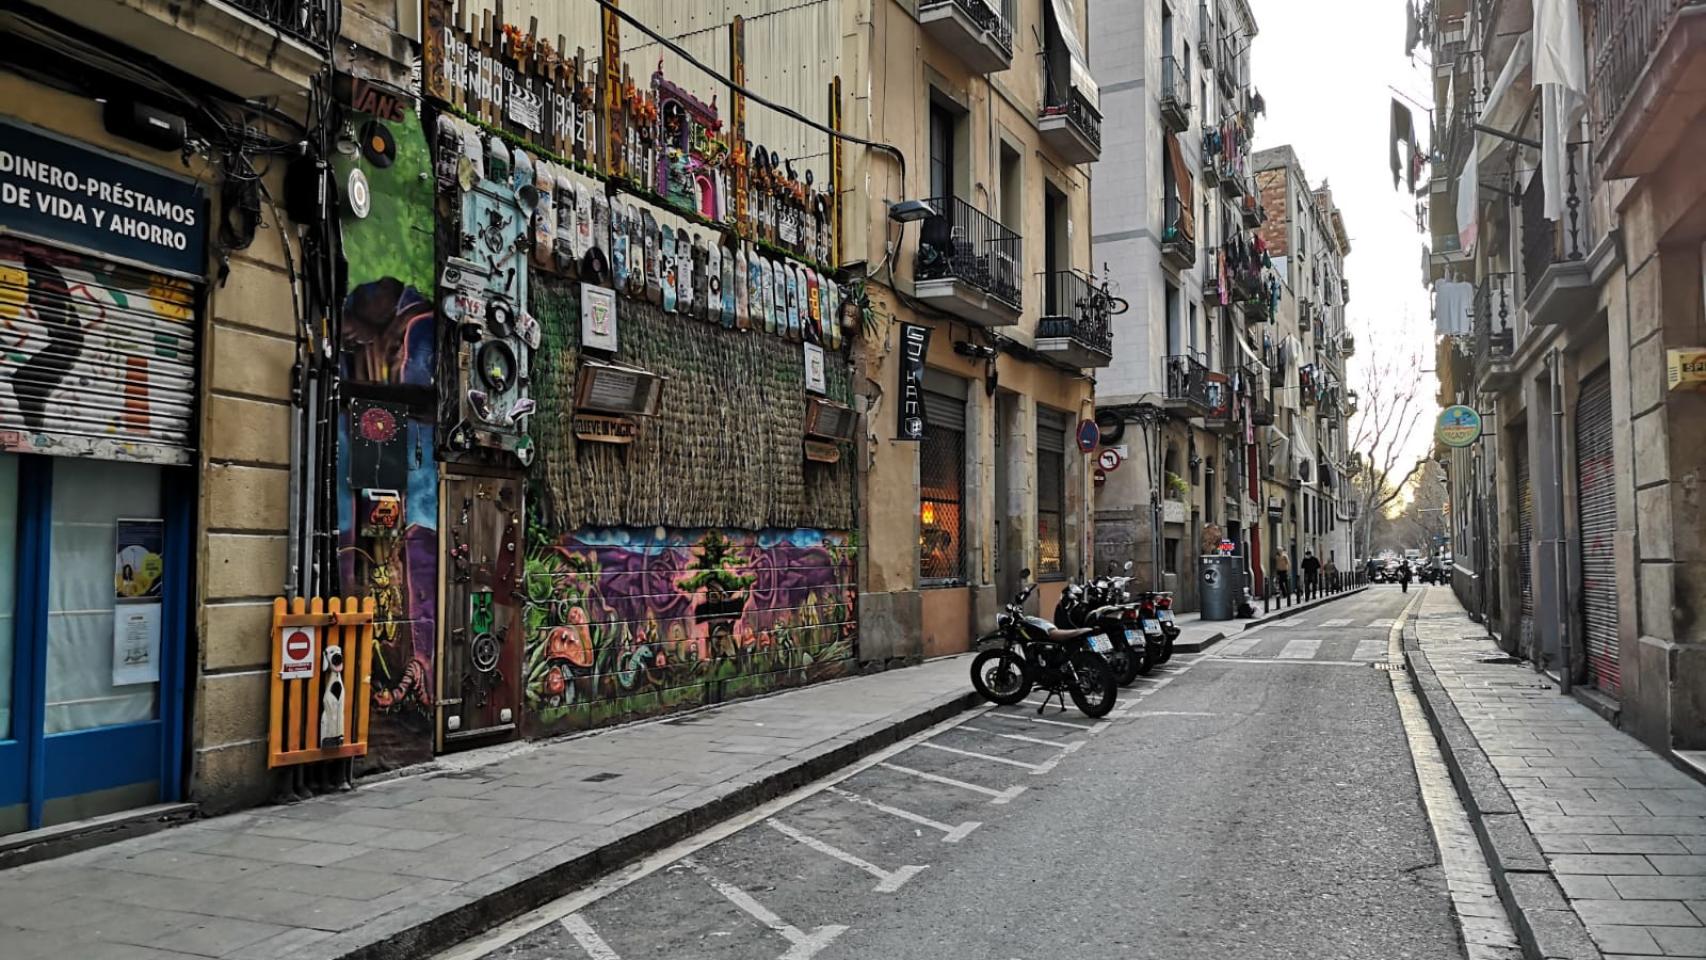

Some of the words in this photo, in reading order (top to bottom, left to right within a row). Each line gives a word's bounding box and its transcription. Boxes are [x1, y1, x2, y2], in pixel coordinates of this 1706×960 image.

[351, 77, 406, 123] VANS
[0, 152, 195, 226] DINERO-PRÉSTAMOS
[2, 182, 31, 208] DE
[36, 191, 87, 225] VIDA
[91, 207, 106, 228] Y
[109, 214, 187, 251] AHORRO
